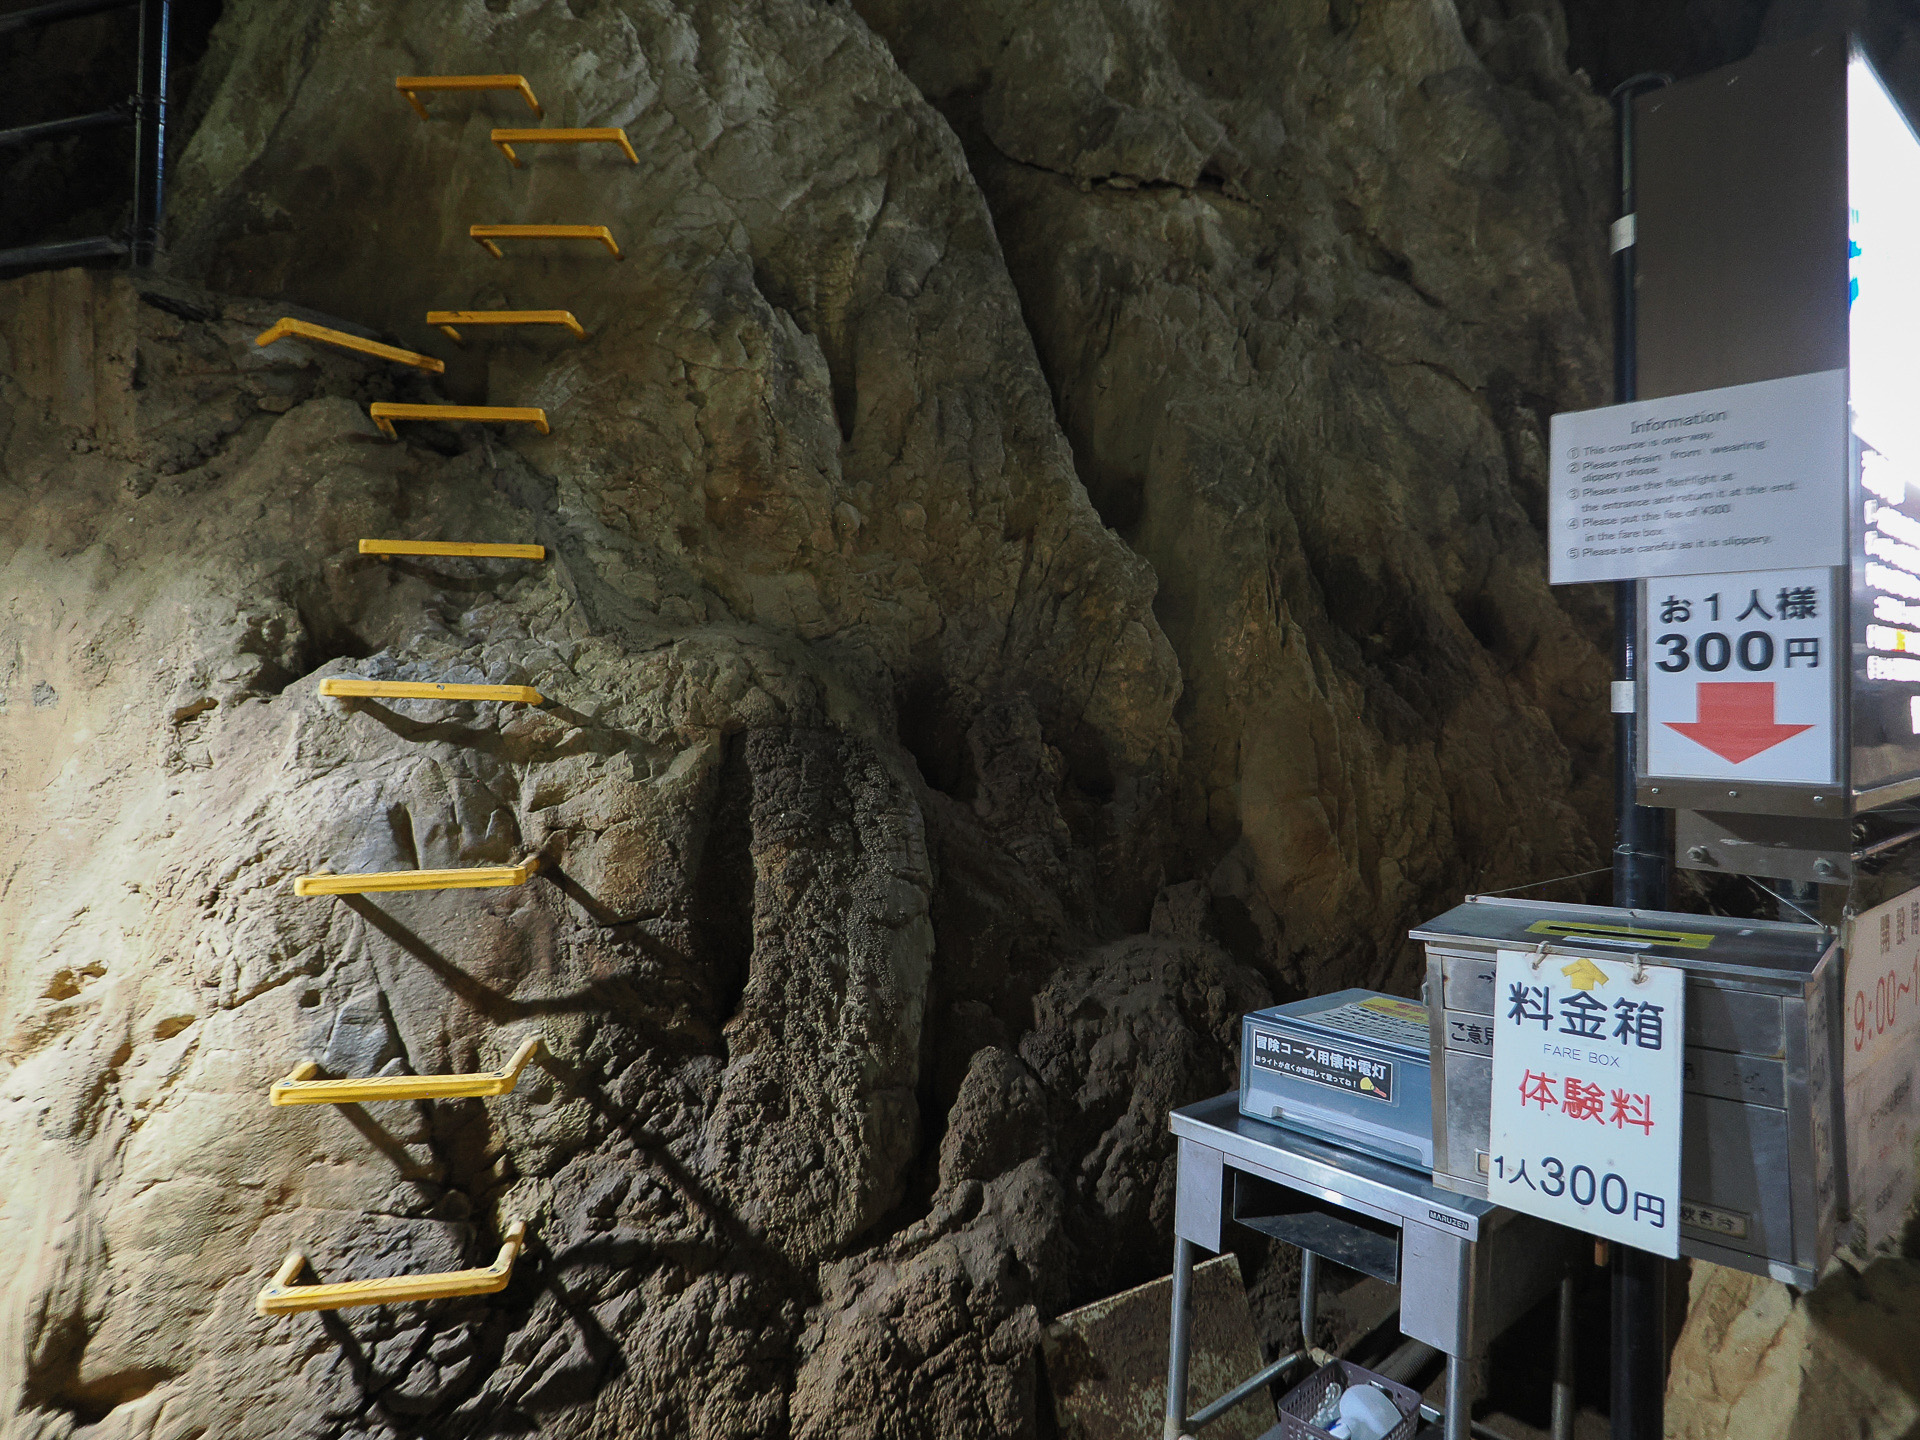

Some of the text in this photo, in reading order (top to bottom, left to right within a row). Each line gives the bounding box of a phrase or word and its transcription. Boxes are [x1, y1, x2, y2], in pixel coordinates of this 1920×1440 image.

[1630, 409, 1727, 434] Information
[1582, 459, 1618, 471] Please
[1621, 453, 1662, 466] refrain
[1670, 448, 1702, 459] from
[1710, 440, 1768, 454] wearing
[1583, 445, 1605, 456] This
[1608, 440, 1647, 452] course
[1648, 438, 1658, 446] is
[1581, 470, 1622, 483] slippery
[1582, 486, 1618, 497] Please
[1621, 484, 1640, 493] use
[1643, 480, 1662, 491] the
[1720, 472, 1735, 481] at
[1581, 503, 1598, 513] the
[1602, 498, 1651, 510] entrance
[1653, 495, 1674, 505] and
[1715, 489, 1726, 498] it
[1729, 488, 1743, 497] at
[1745, 485, 1767, 495] the
[1582, 516, 1617, 527] Please
[1620, 514, 1640, 525] put
[1642, 511, 1661, 521] the
[1664, 509, 1683, 519] fee
[1685, 507, 1699, 517] of
[1582, 547, 1618, 558] Please
[1621, 544, 1634, 554] be
[1637, 541, 1675, 554] careful
[1679, 541, 1693, 549] as
[1696, 538, 1706, 547] it
[1708, 537, 1720, 547] is
[1585, 533, 1595, 542] in
[1598, 531, 1616, 540] the
[1618, 529, 1640, 540] fare
[1659, 586, 1818, 624] お1人様
[1654, 630, 1820, 673] 300円
[1507, 981, 1665, 1051] 料金箱
[1256, 1035, 1387, 1080] 冒険コース用懐中電灯
[1543, 1043, 1620, 1069] FARE BOX
[1518, 1068, 1655, 1136] 体験料
[1493, 1155, 1666, 1229] 1人300円
[1430, 1211, 1468, 1230] MARUZEN
